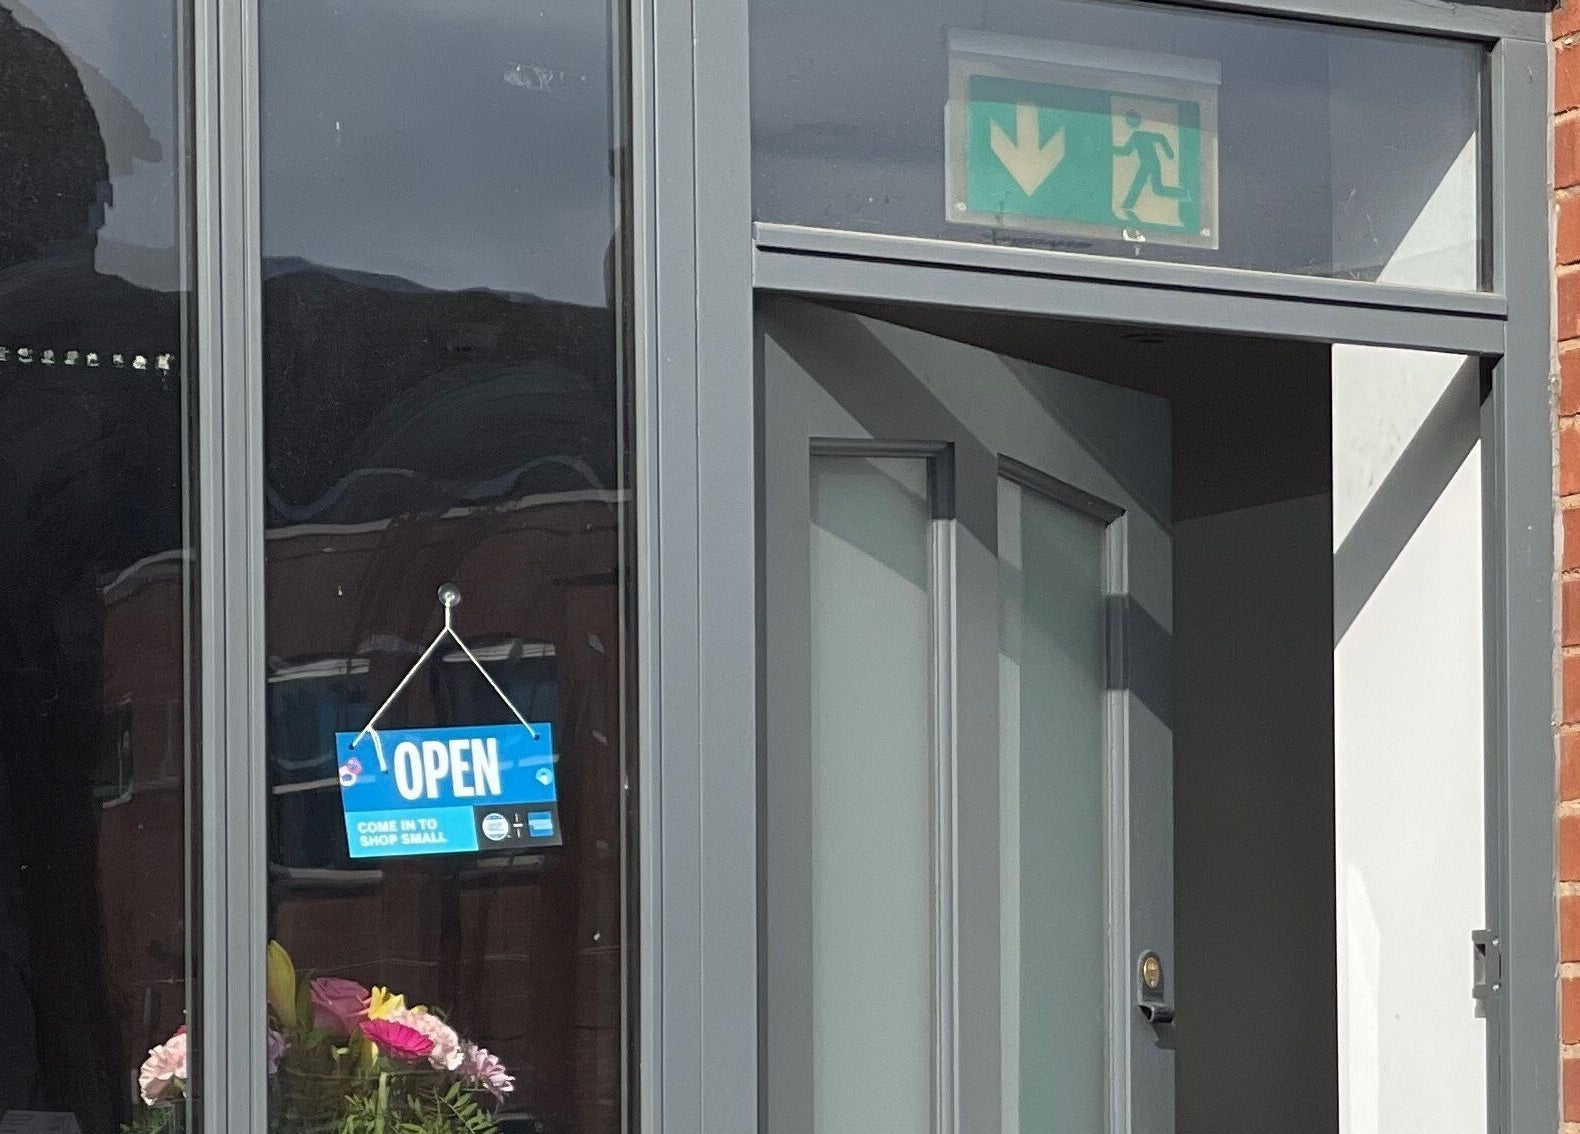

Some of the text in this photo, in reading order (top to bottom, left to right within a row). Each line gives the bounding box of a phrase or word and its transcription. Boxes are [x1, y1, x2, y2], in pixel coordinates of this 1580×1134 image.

[394, 737, 502, 800] OPEN
[357, 818, 438, 834] COME IN TO
[360, 831, 447, 847] SHOP SMALL
